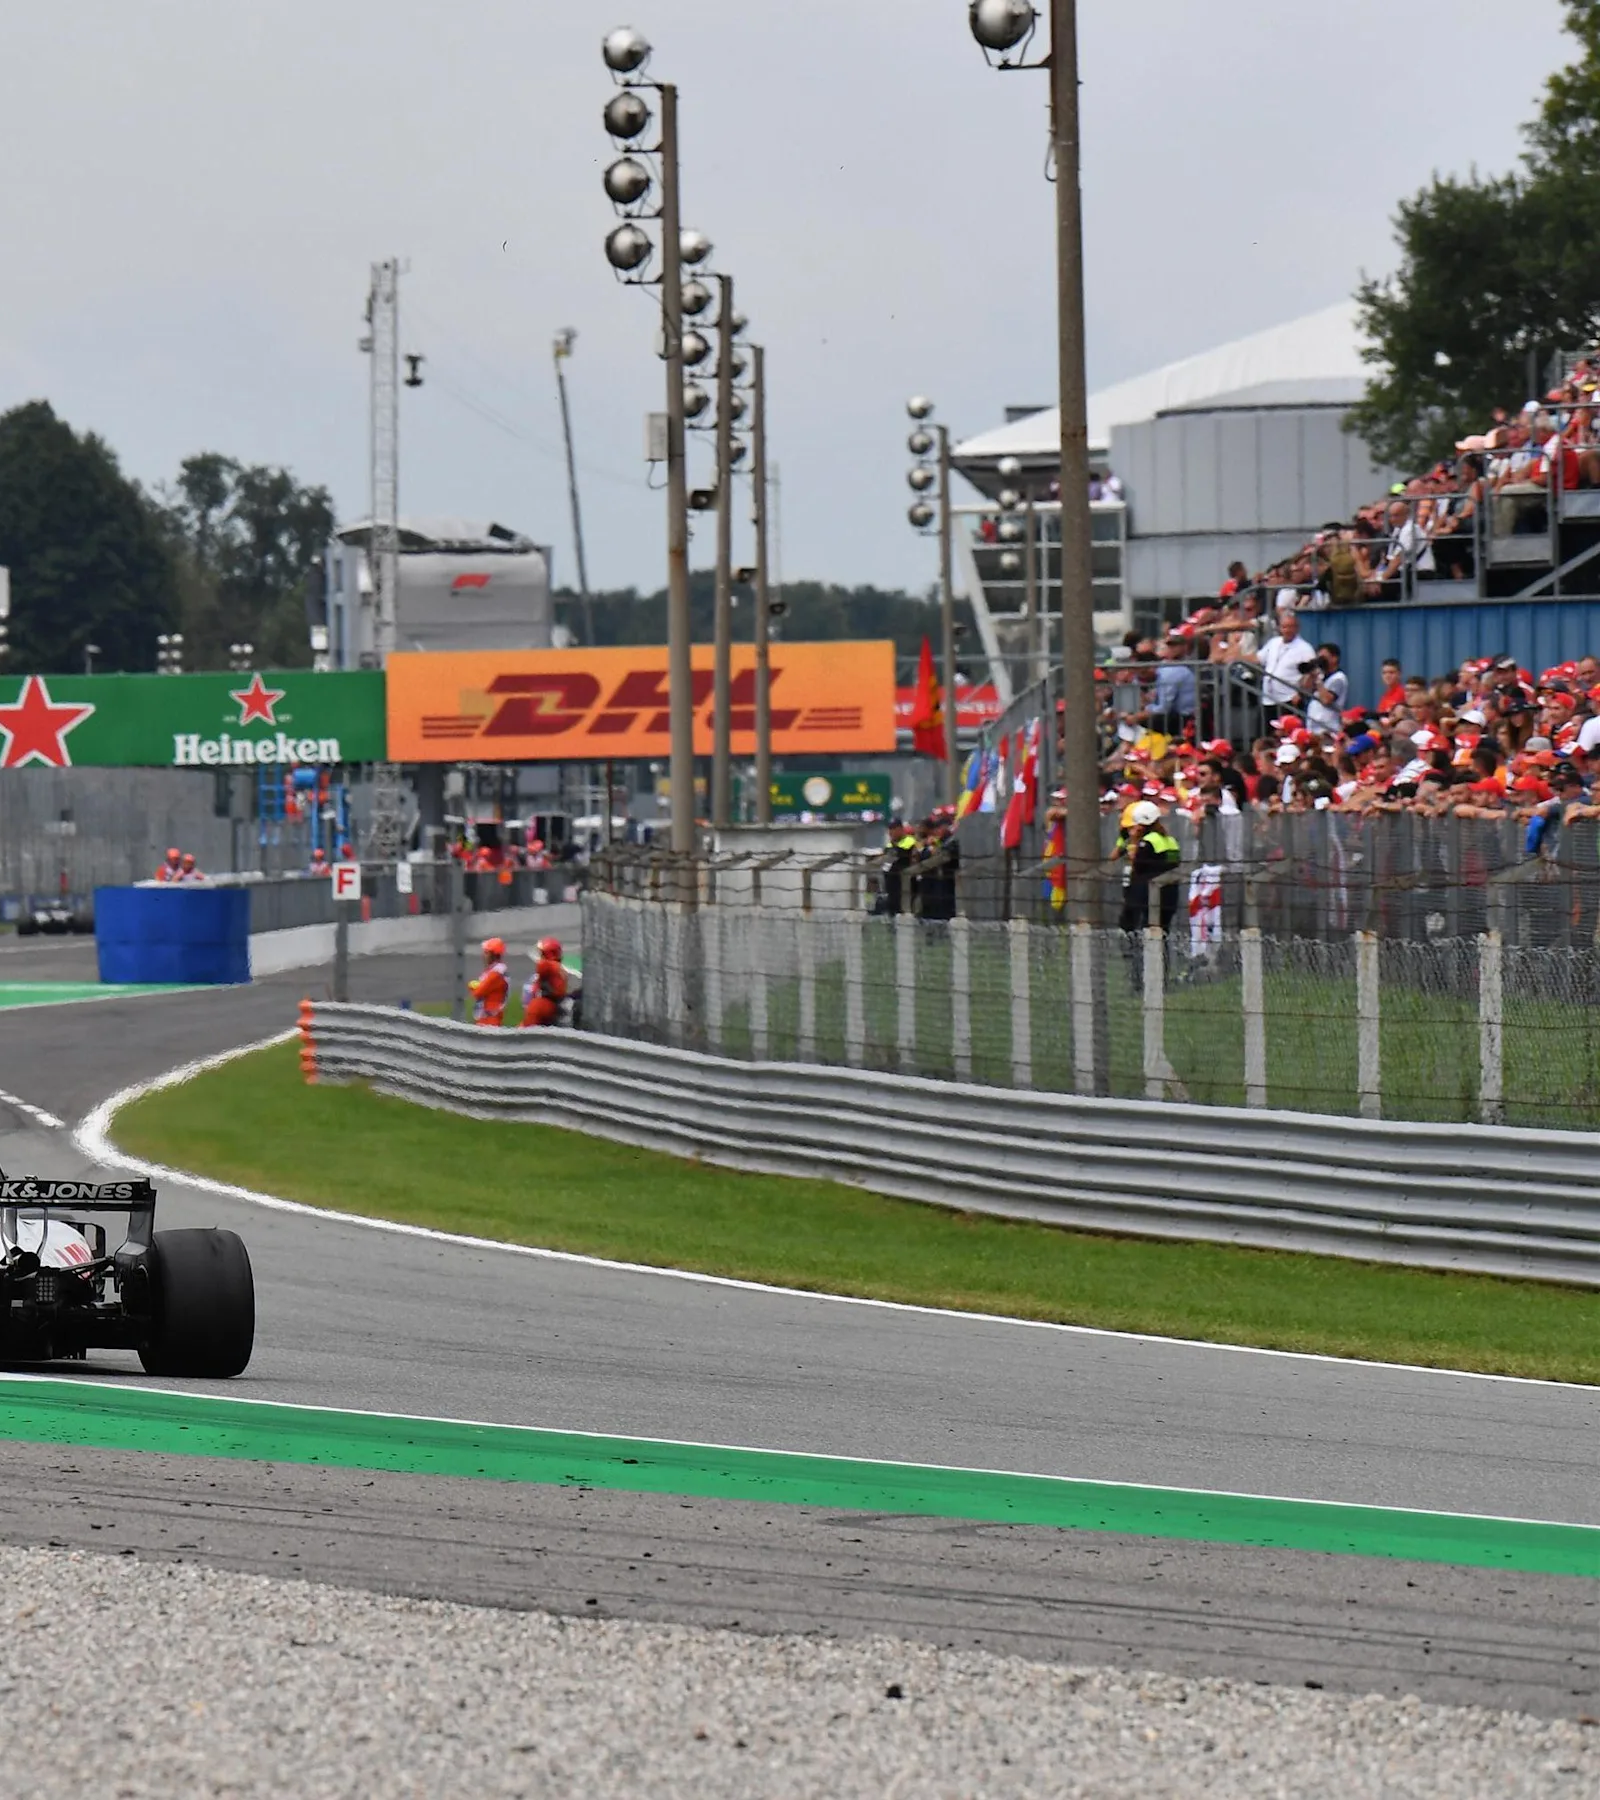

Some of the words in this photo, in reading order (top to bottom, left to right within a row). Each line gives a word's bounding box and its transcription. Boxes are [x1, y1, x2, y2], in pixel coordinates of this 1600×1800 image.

[481, 668, 801, 737] DHL
[173, 732, 342, 765] Heineken
[336, 867, 356, 894] F
